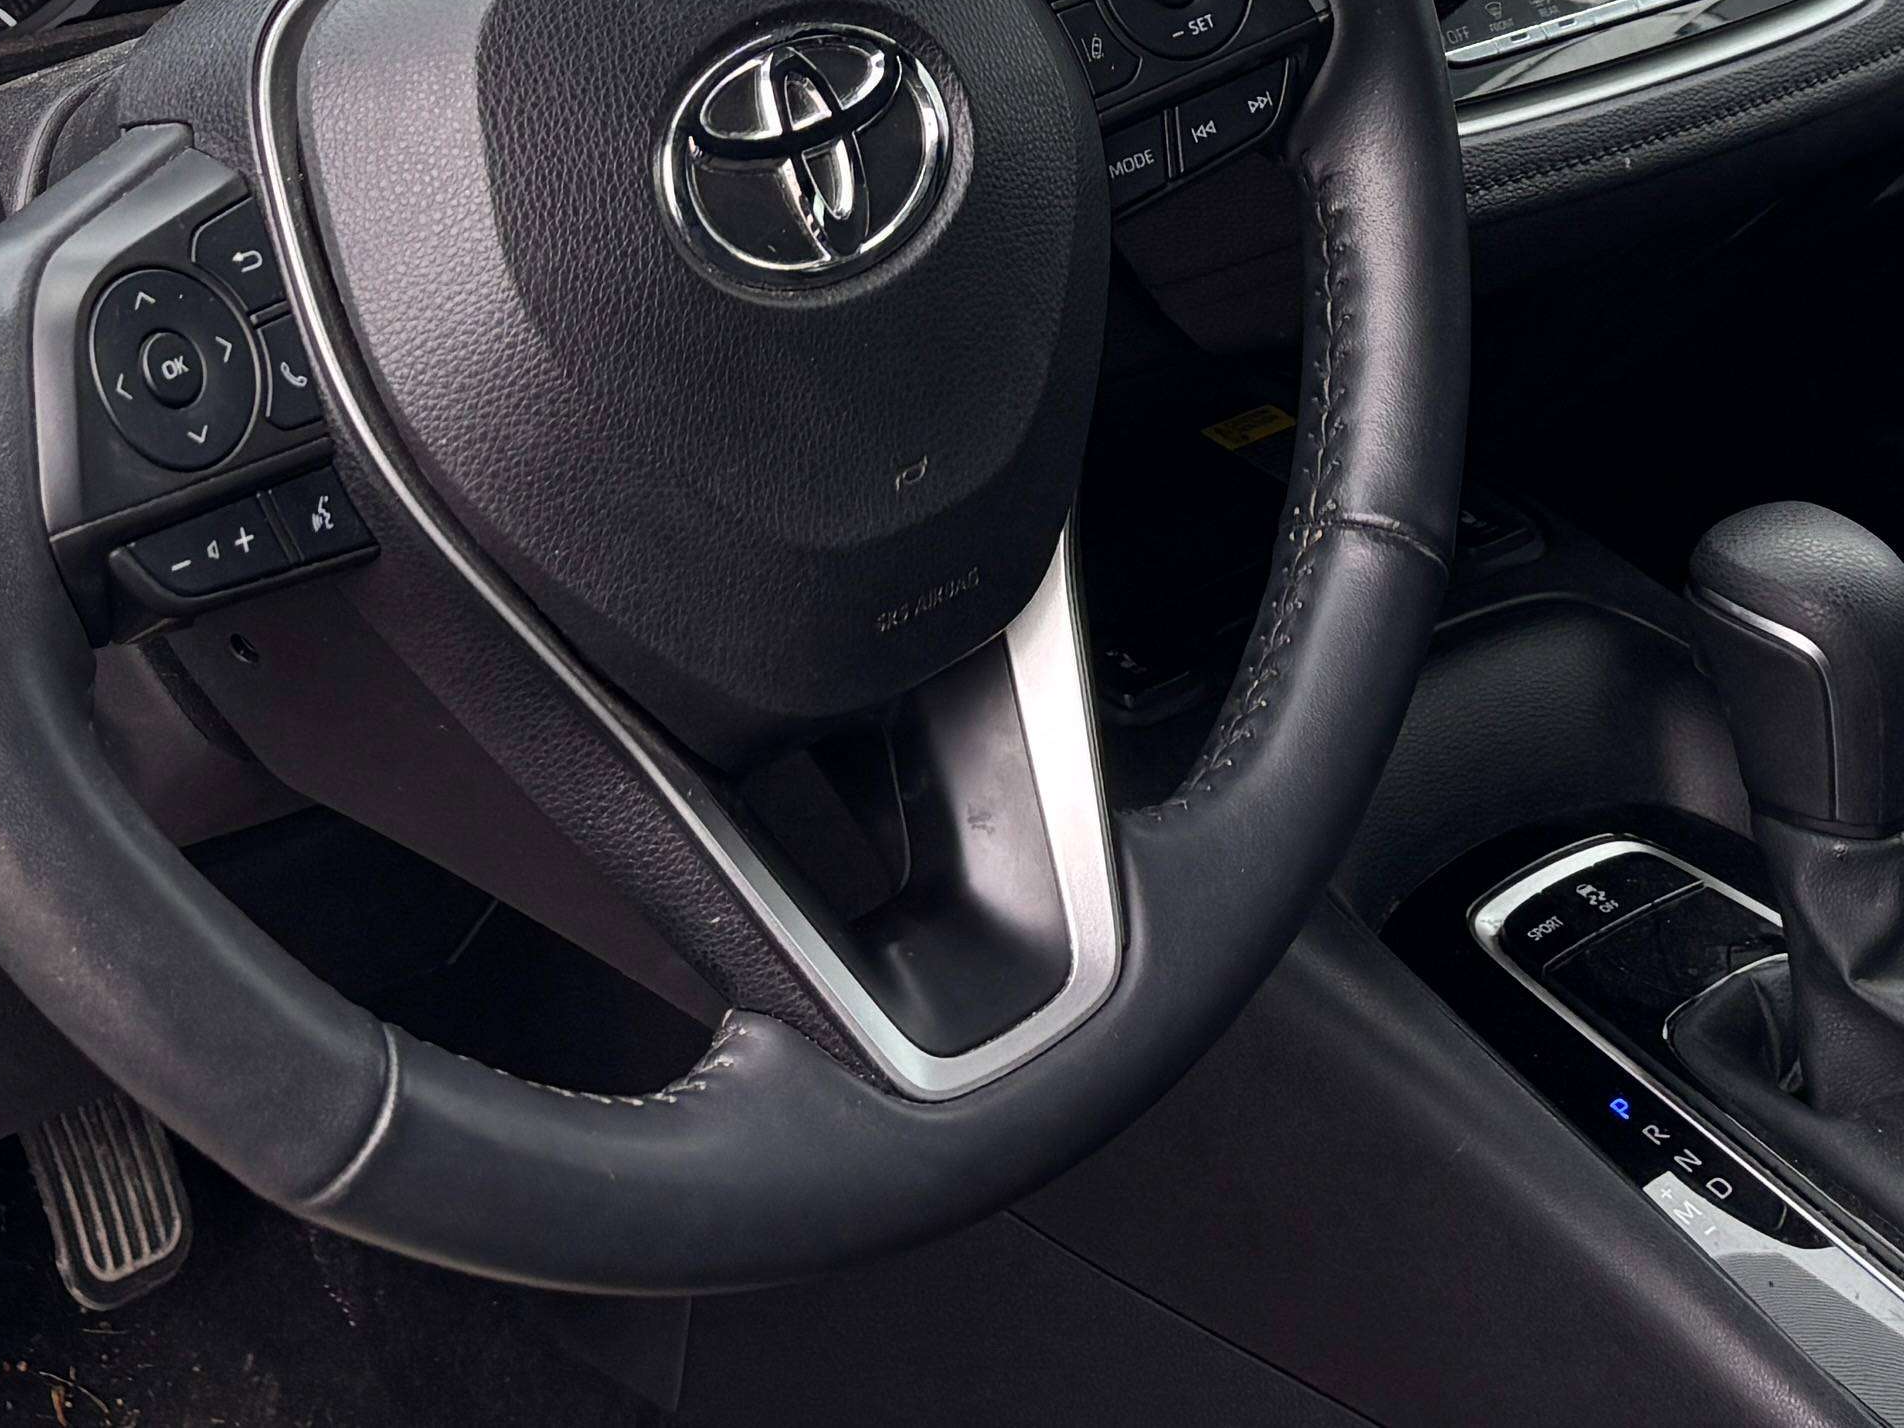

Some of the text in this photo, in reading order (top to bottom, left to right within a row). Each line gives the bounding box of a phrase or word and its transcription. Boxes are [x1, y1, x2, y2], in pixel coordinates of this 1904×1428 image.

[1188, 13, 1215, 36] SET
[1447, 25, 1470, 44] OFF
[1108, 149, 1155, 179] MODE
[161, 355, 189, 380] OK
[1527, 915, 1564, 941] SPORT
[1609, 1098, 1630, 1120] P
[1642, 1124, 1671, 1146] R
[1673, 1148, 1703, 1173] N
[1705, 1177, 1733, 1200] D
[1673, 1200, 1703, 1225] M
